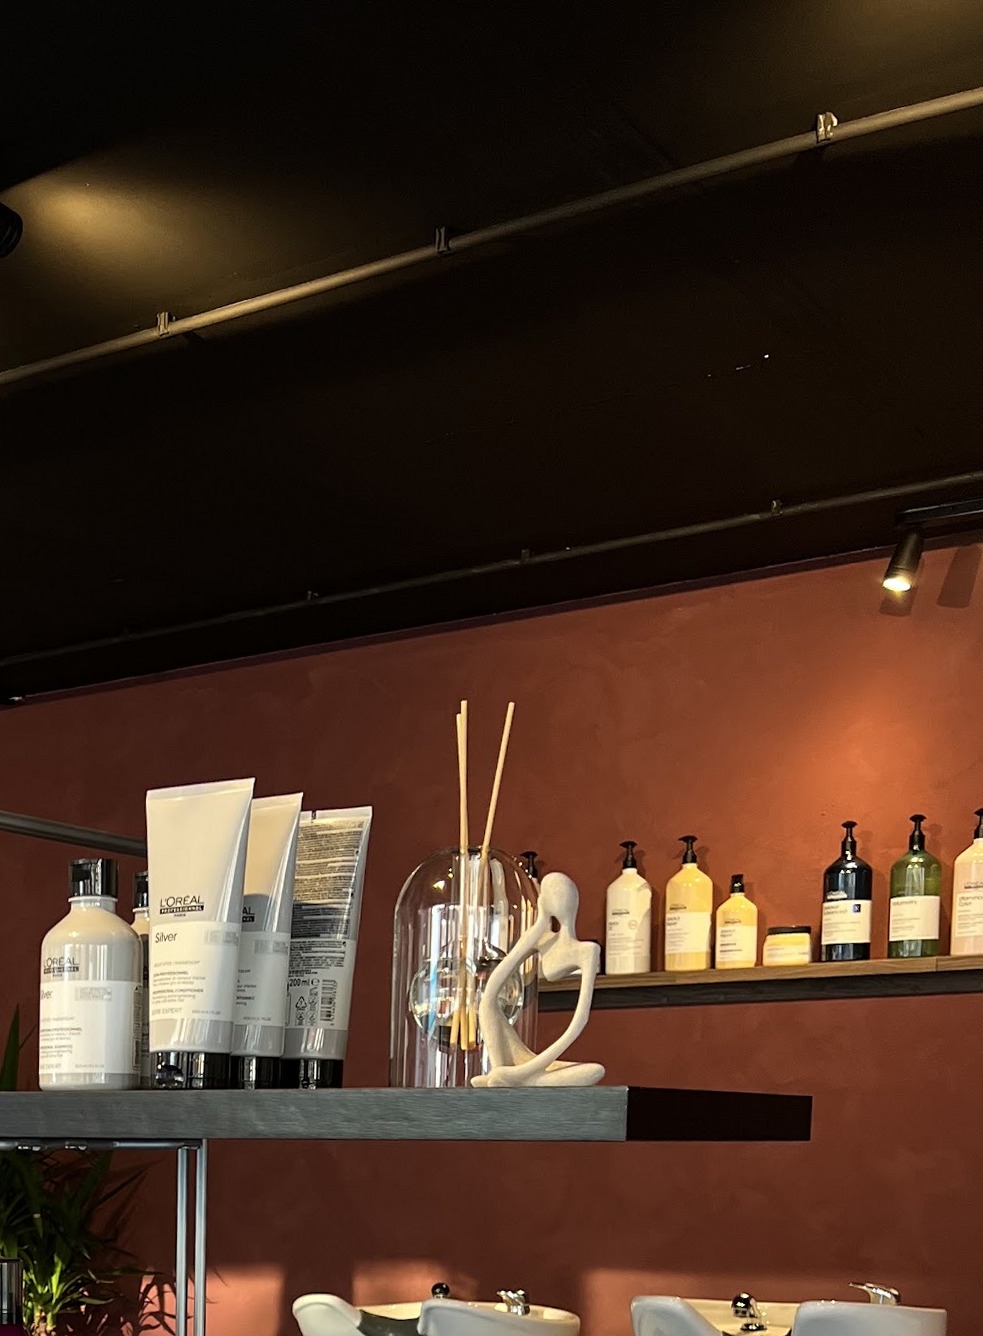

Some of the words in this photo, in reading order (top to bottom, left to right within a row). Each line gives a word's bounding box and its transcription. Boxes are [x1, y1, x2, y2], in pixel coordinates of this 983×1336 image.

[160, 895, 204, 908] L'ORÉAL
[160, 905, 204, 914] PROFESSIONNEL
[155, 932, 177, 944] Silver
[289, 978, 303, 987] 200
[303, 978, 310, 986] ml
